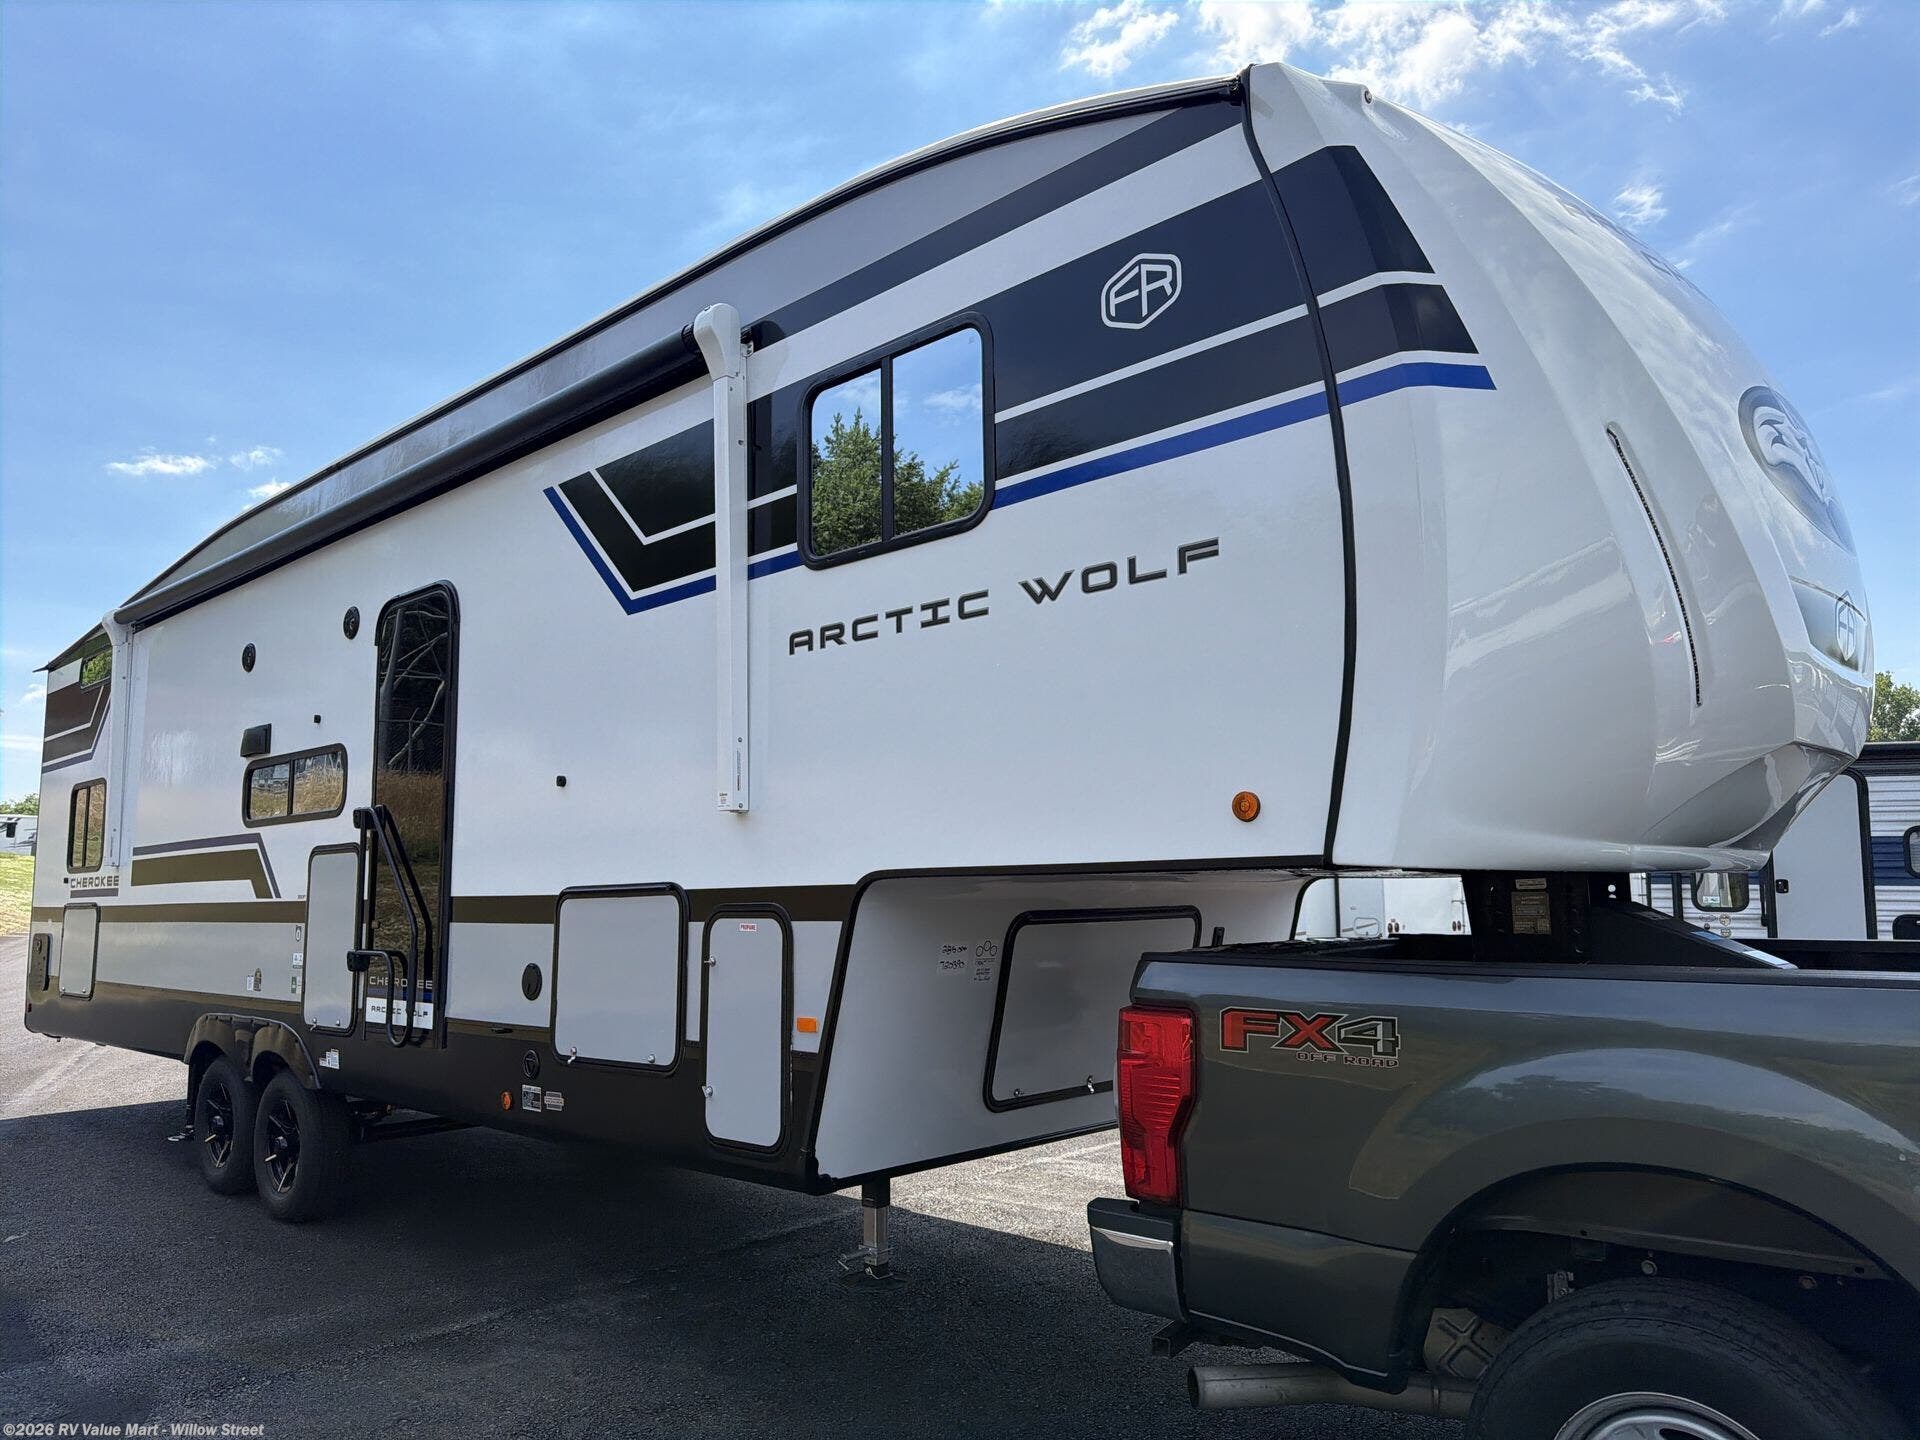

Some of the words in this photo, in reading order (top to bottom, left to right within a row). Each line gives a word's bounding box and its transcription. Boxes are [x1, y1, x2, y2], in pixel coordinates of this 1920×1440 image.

[789, 589, 989, 655] ARCTIC
[1018, 537, 1220, 605] WOLF
[70, 875, 120, 889] CHEROKEE
[369, 976, 433, 989] CHEROEE
[1220, 1006, 1400, 1058] FX4
[1297, 1052, 1336, 1063] OFF
[1344, 1055, 1400, 1068] ROAD
